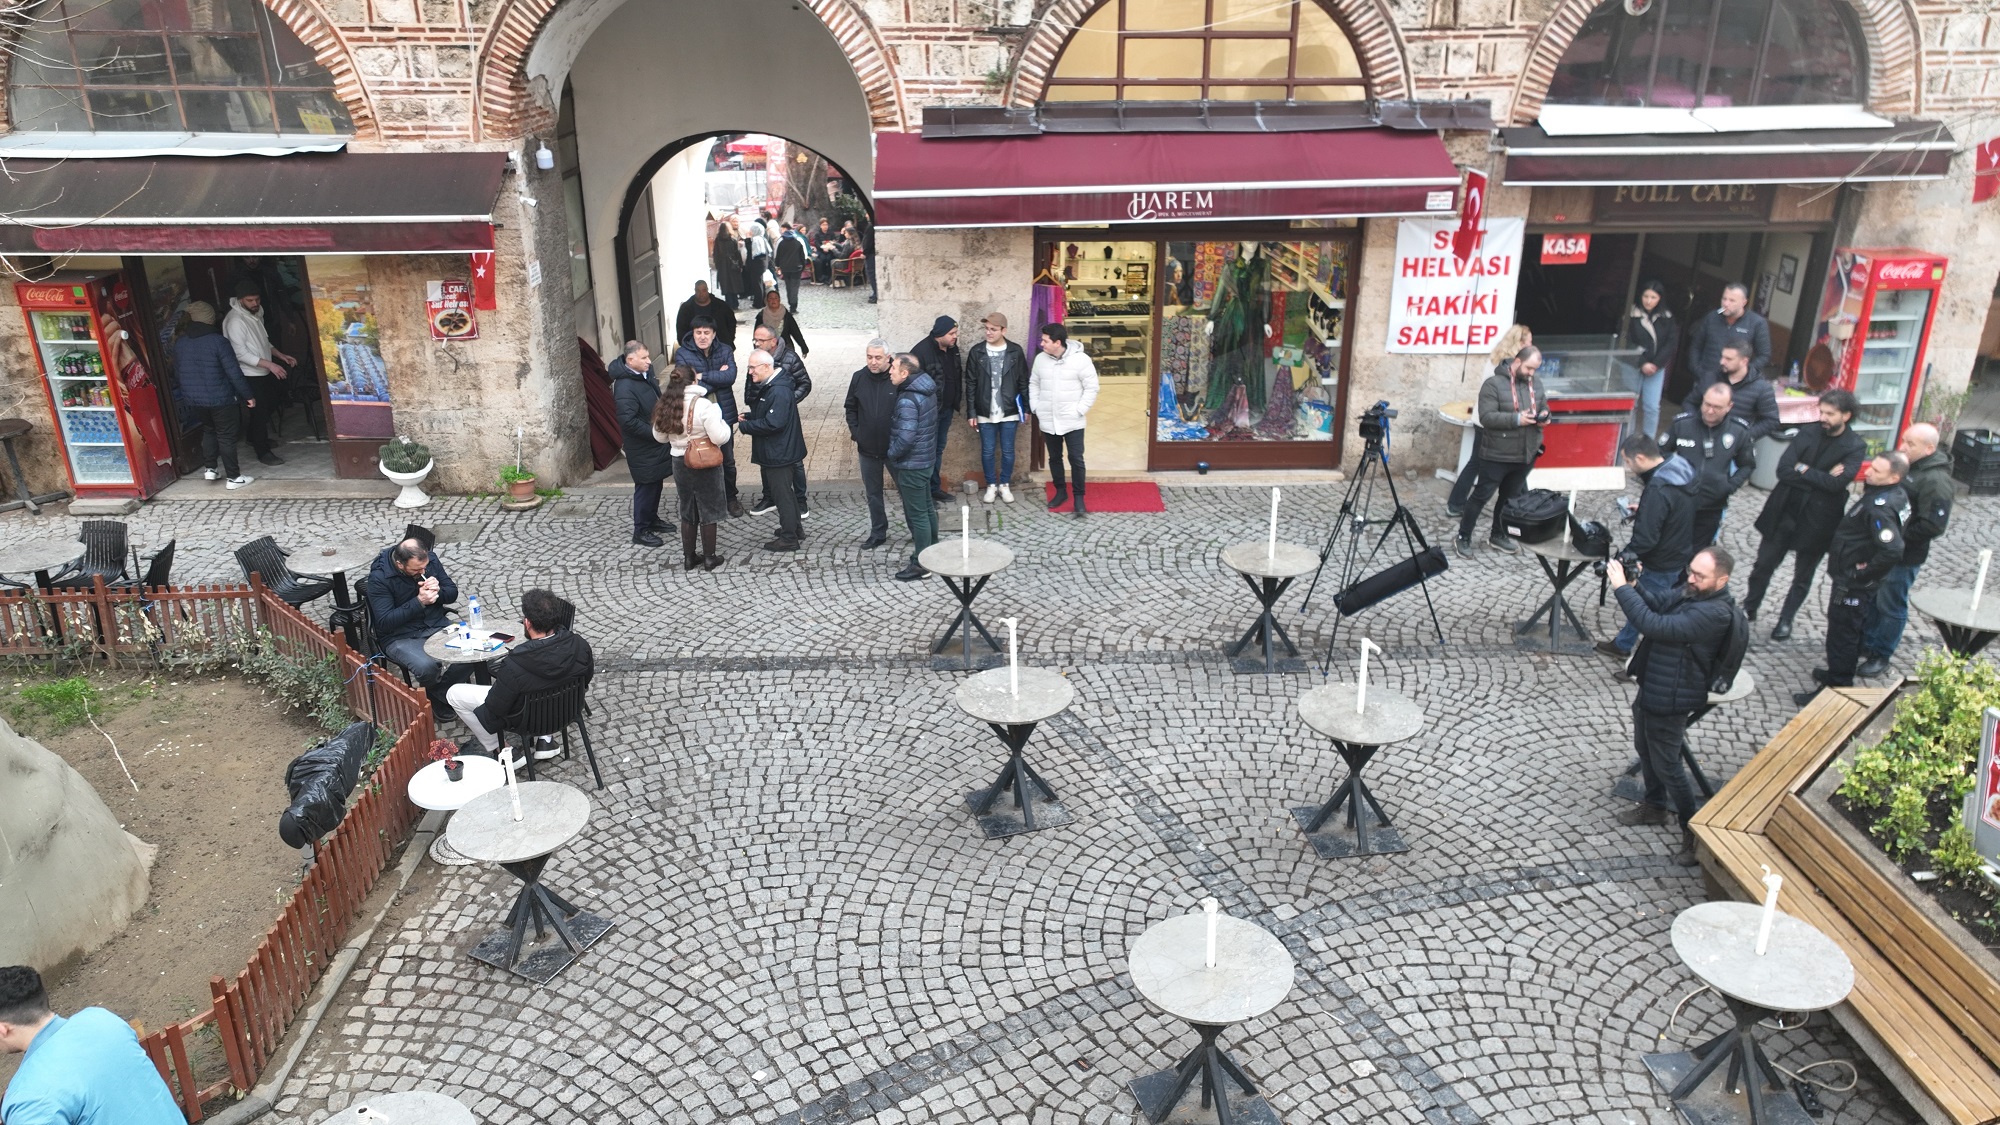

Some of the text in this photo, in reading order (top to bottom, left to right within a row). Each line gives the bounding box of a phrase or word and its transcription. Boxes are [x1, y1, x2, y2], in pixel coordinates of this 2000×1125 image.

[1127, 191, 1213, 219] HAREM
[1543, 238, 1587, 255] KASA
[1402, 255, 1511, 277] HELVASI
[1397, 325, 1498, 346] SAHLEP
